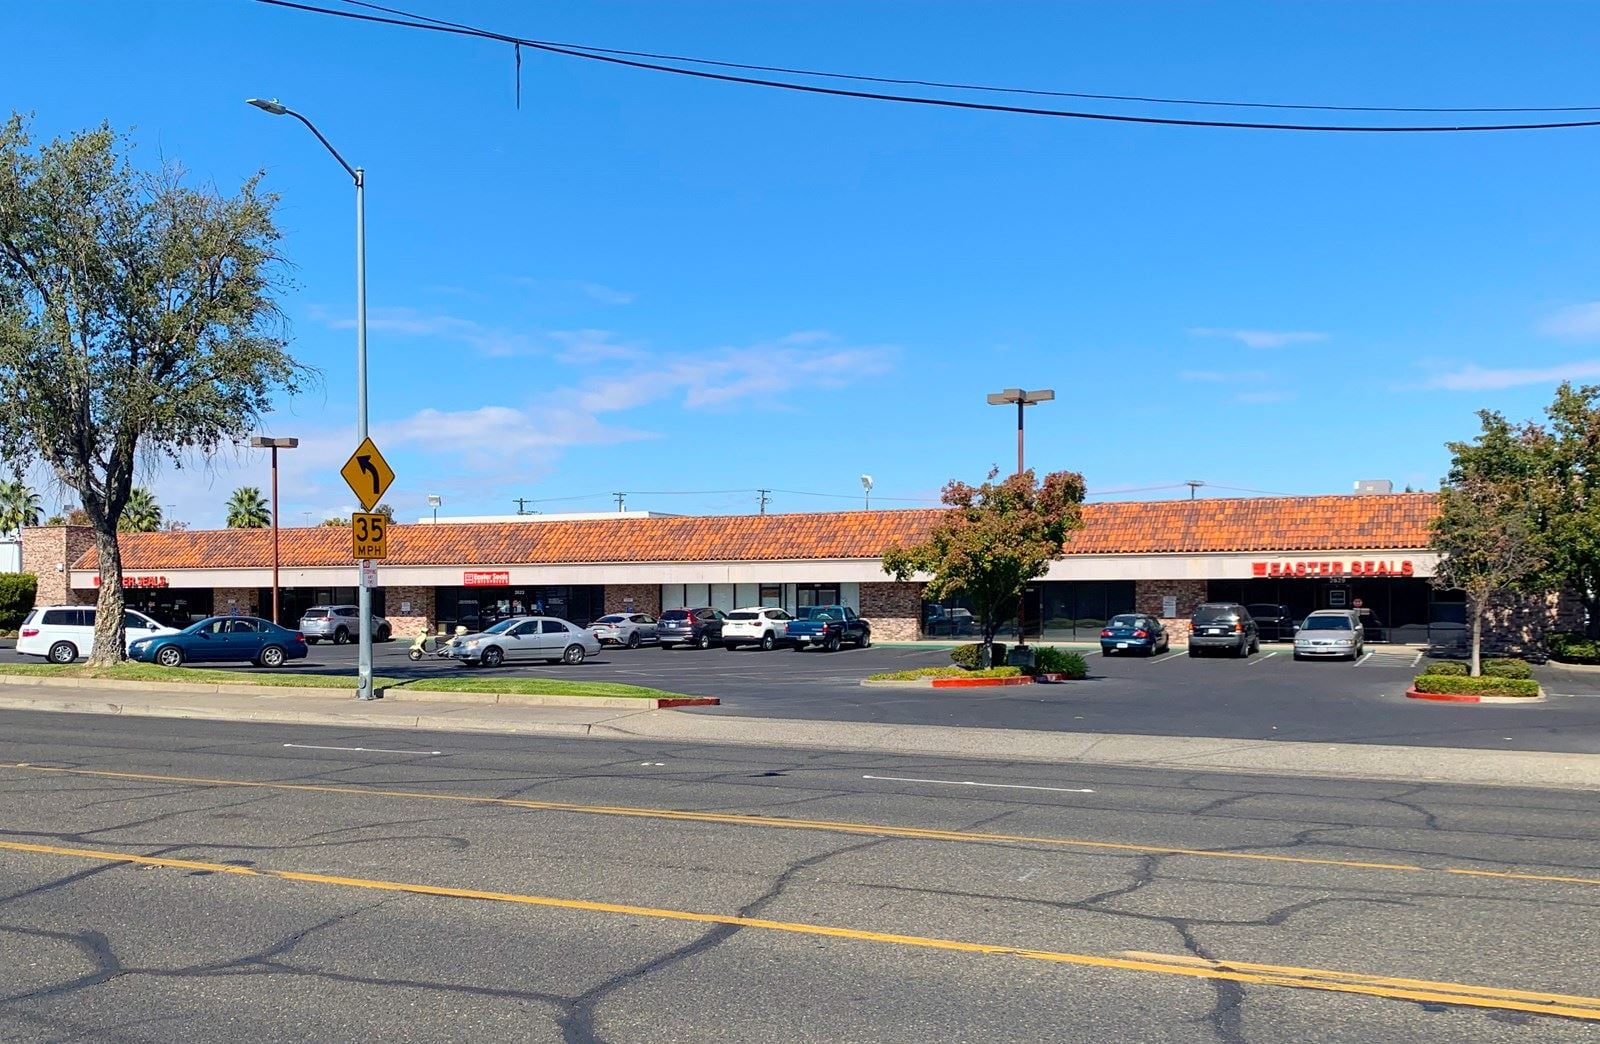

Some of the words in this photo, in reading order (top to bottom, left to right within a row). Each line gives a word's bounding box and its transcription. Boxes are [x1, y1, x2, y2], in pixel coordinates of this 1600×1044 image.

[356, 517, 384, 542] 35
[358, 545, 381, 556] MPH
[1270, 561, 1344, 577] EASTER
[1351, 560, 1414, 576] SEALS
